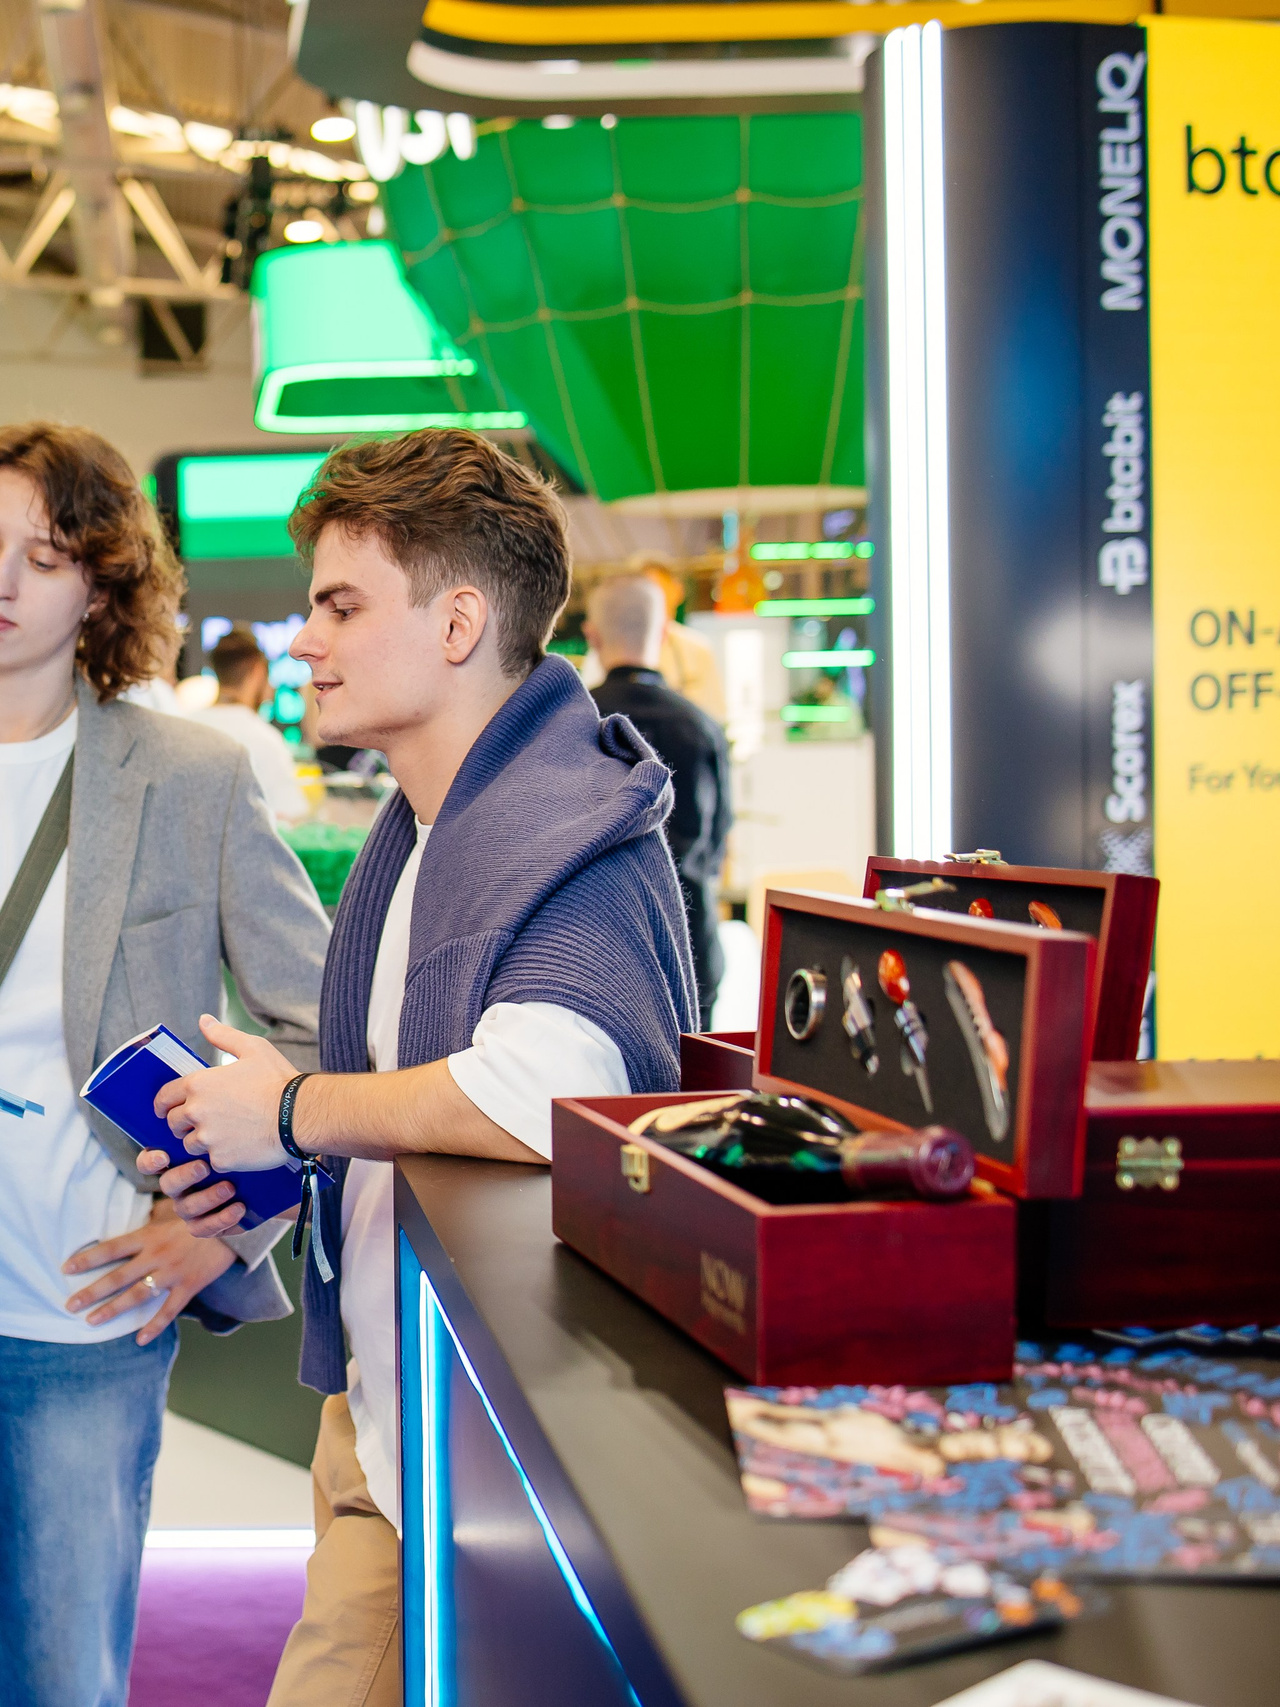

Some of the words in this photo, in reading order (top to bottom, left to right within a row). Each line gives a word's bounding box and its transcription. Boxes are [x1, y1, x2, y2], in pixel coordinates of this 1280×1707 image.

[1096, 50, 1147, 310] MONELIQ
[1190, 610, 1280, 647] ON-
[1191, 672, 1280, 711] OFF
[1105, 679, 1145, 823] Scorex
[1189, 763, 1234, 792] For
[1243, 762, 1280, 792] Yo
